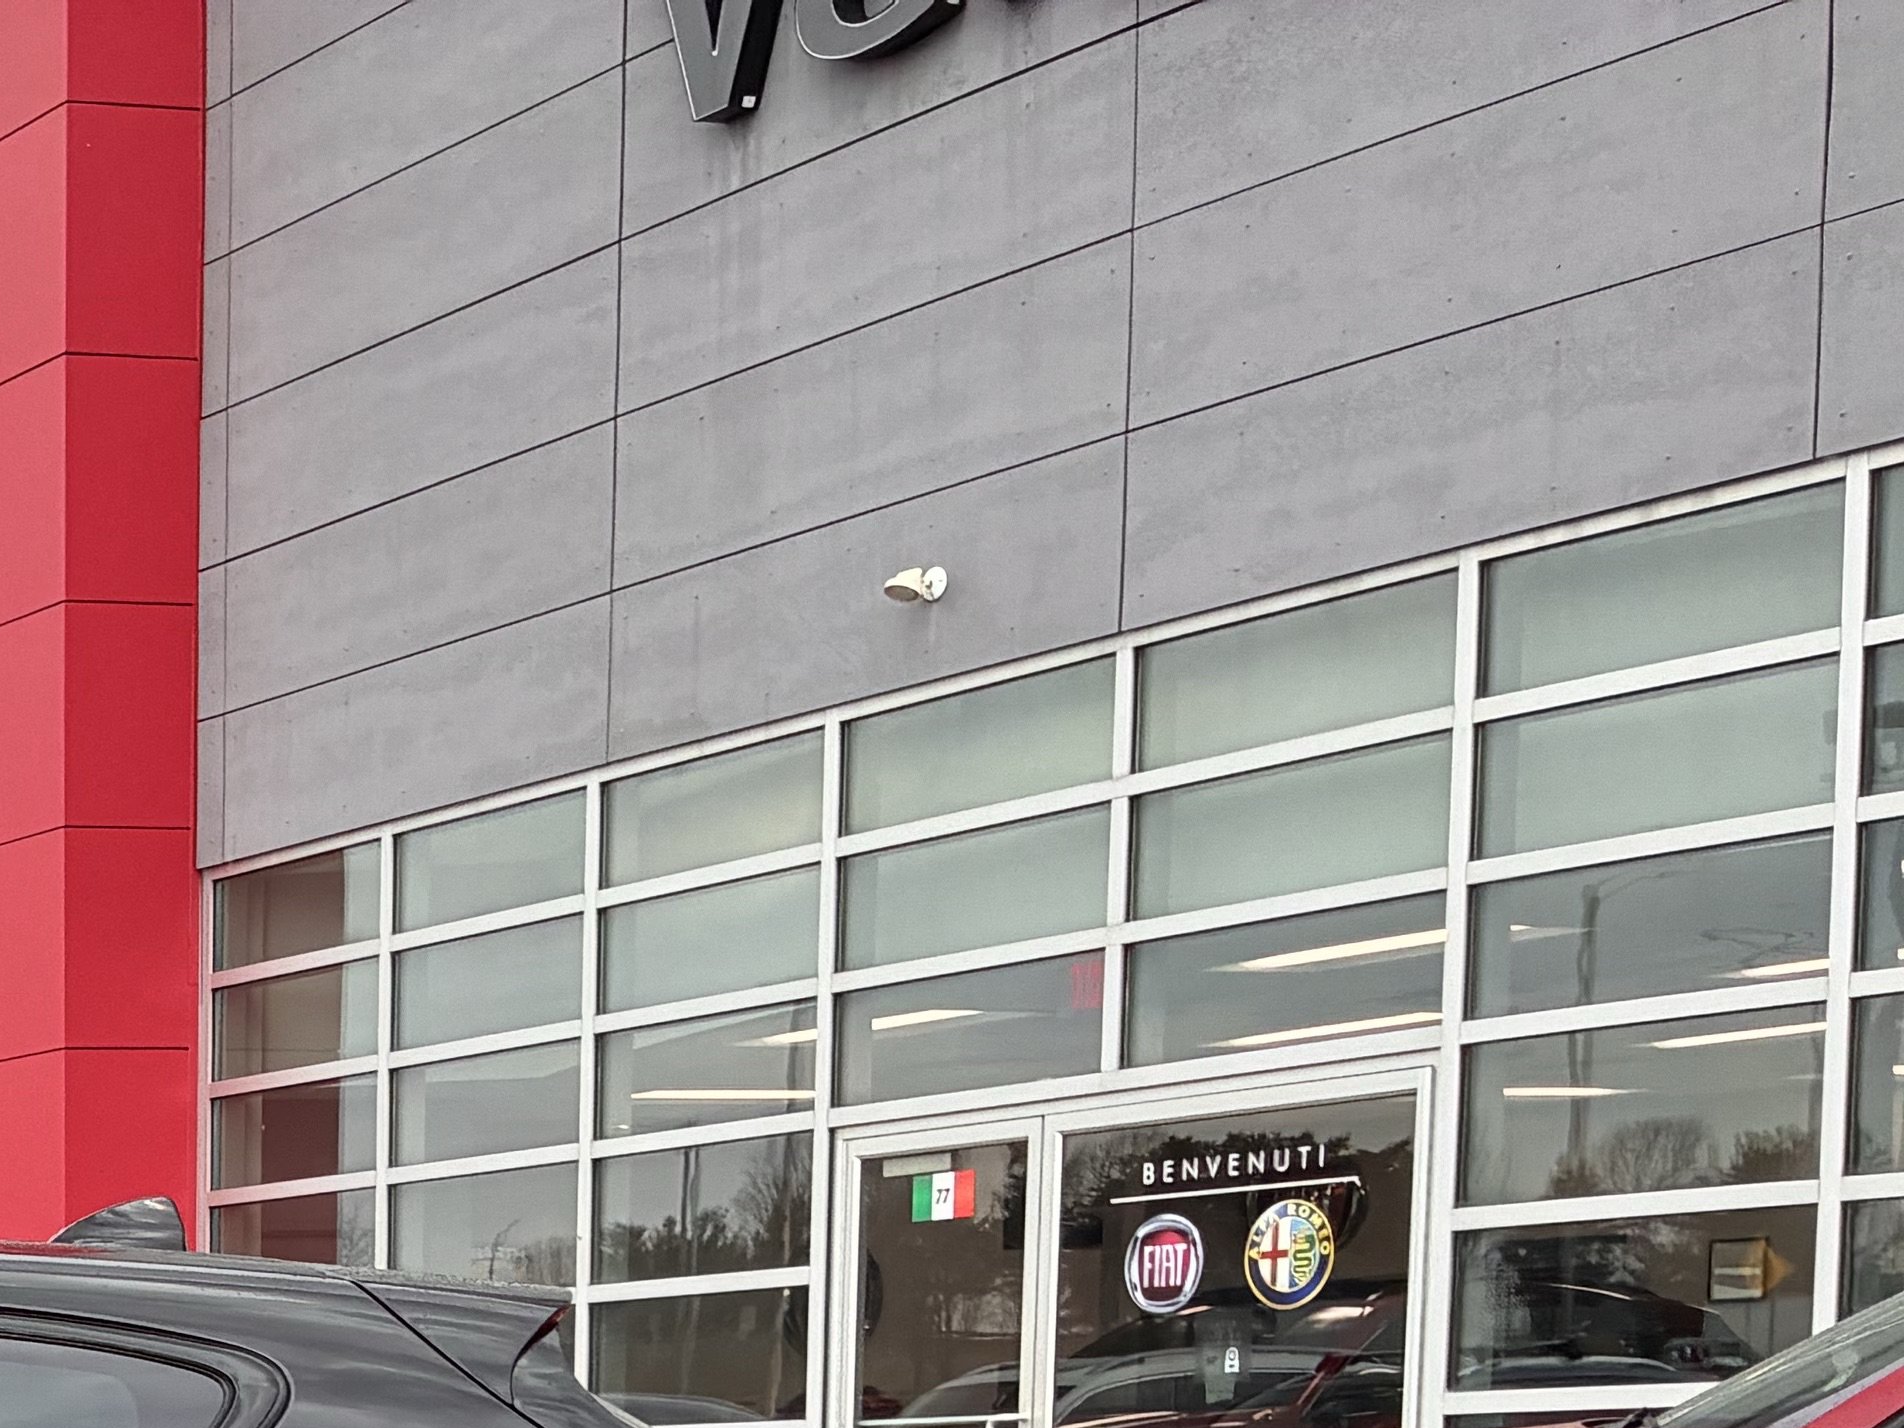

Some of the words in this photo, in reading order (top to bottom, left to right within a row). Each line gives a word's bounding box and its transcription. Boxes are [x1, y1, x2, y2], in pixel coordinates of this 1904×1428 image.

[1142, 1143, 1326, 1186] BENVENUTI
[1286, 1202, 1330, 1257] ROMEO
[1143, 1243, 1189, 1289] FIAT
